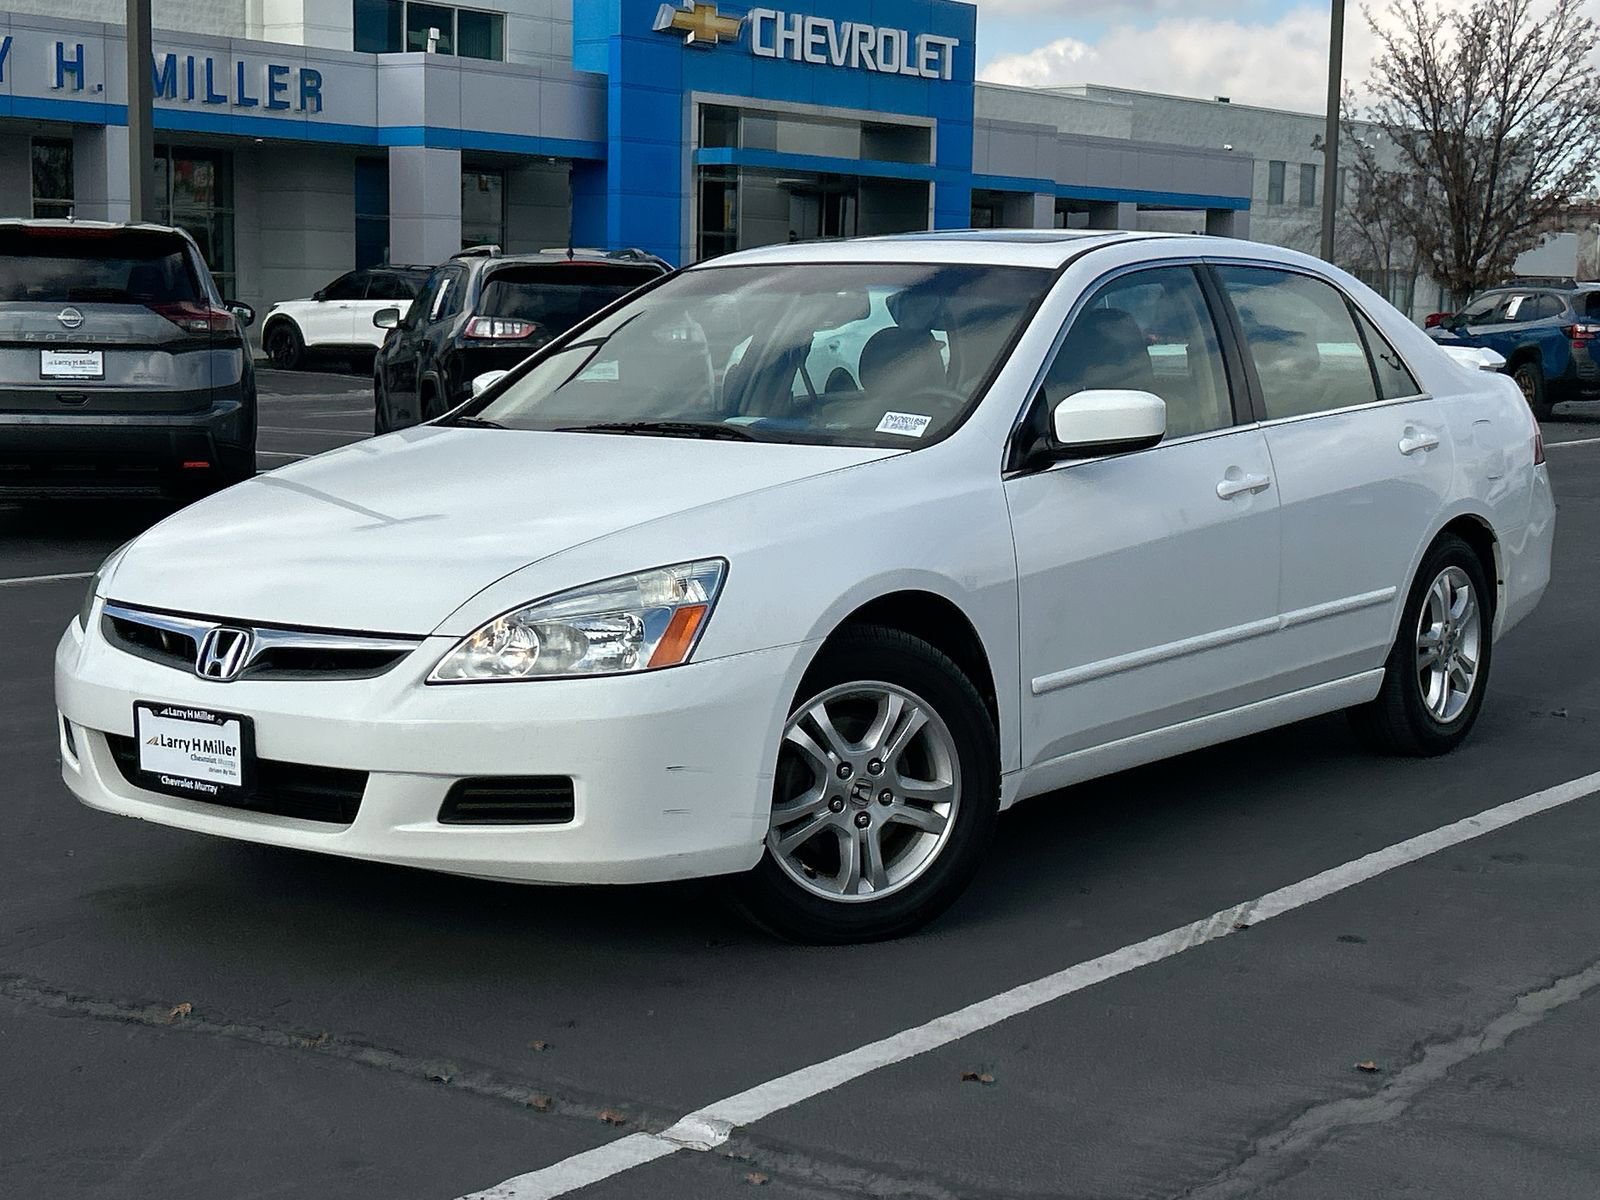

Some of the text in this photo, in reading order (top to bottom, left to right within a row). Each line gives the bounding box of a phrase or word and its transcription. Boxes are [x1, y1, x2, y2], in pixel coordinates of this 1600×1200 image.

[750, 7, 959, 80] CHEVROLET
[54, 41, 103, 91] H.
[152, 53, 323, 113] MILLER
[168, 707, 188, 719] Larry
[188, 709, 194, 719] H
[160, 733, 237, 757] Larry H Miller
[160, 775, 218, 795] Chevrolet Murray
